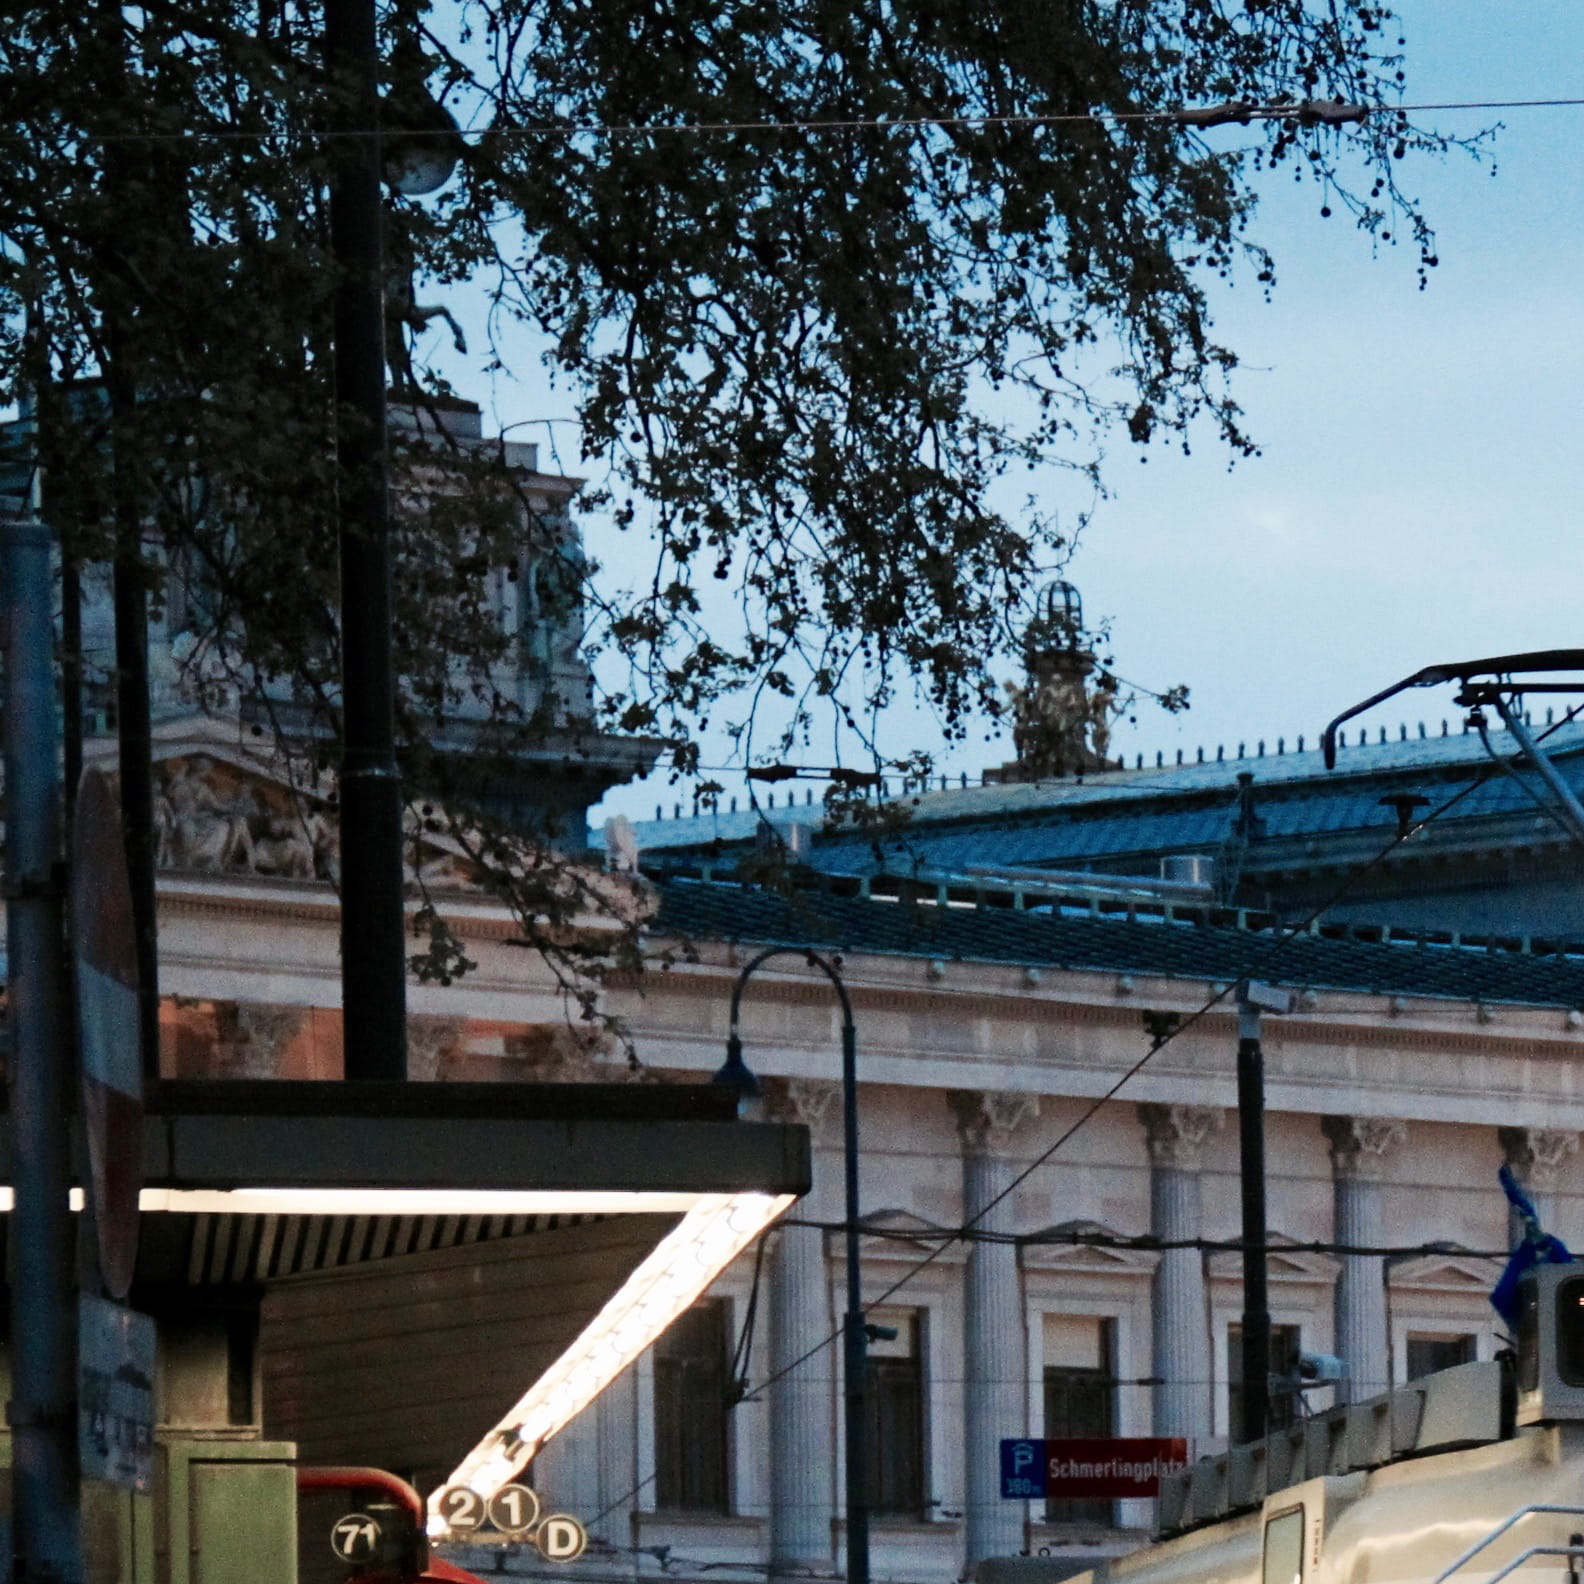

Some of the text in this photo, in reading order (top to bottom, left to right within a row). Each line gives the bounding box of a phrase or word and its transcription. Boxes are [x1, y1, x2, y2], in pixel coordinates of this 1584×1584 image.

[337, 1523, 377, 1555] 71
[448, 1488, 579, 1557] 2 1 D
